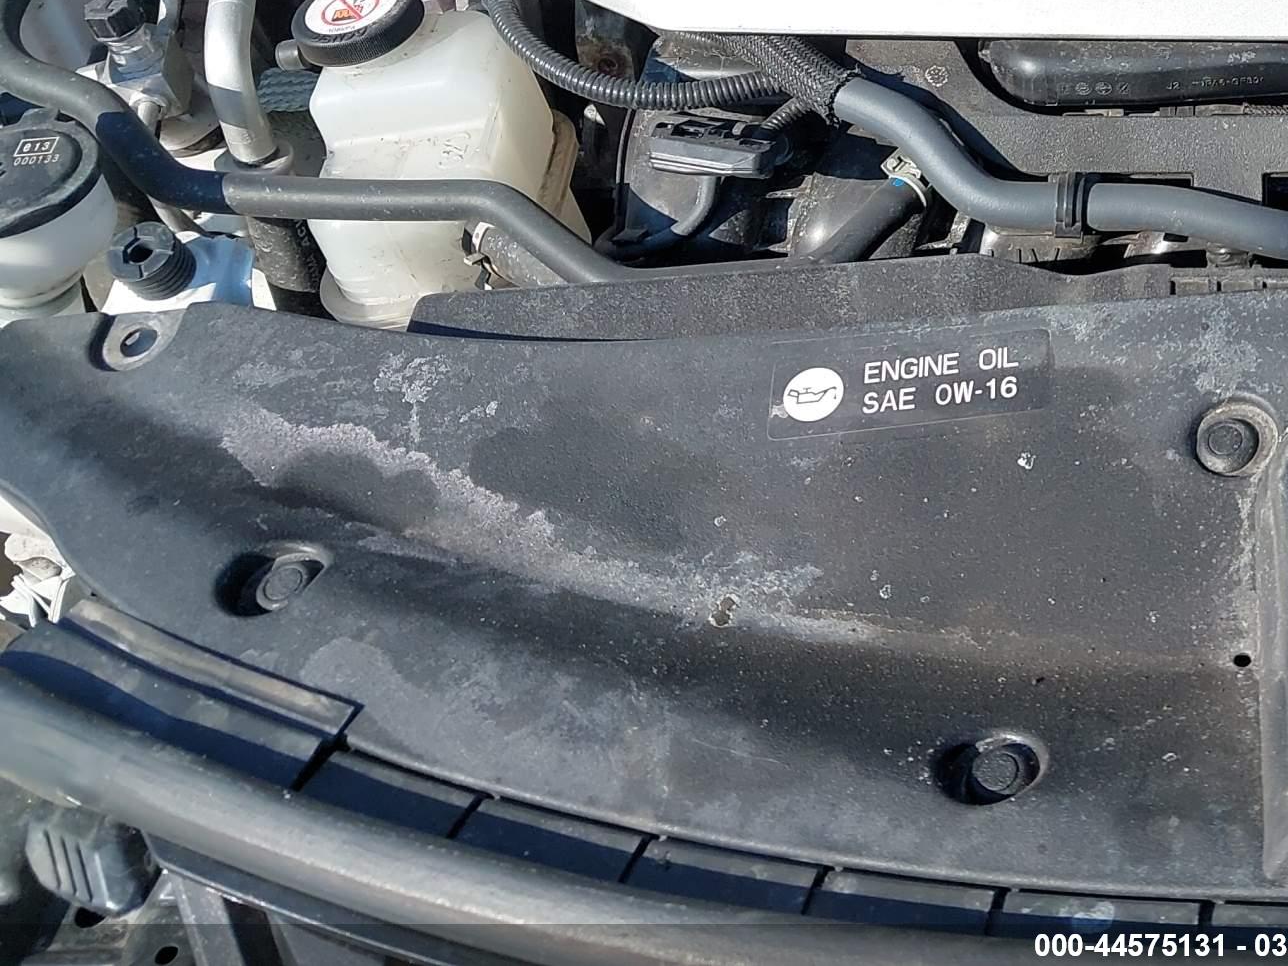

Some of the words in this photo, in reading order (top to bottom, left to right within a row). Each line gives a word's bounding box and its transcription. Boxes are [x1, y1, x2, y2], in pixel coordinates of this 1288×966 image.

[13, 153, 60, 167] 000133
[863, 352, 961, 384] ENGINE
[977, 346, 1020, 371] OIL
[862, 386, 917, 414] SAE
[934, 376, 1018, 407] 0W-16
